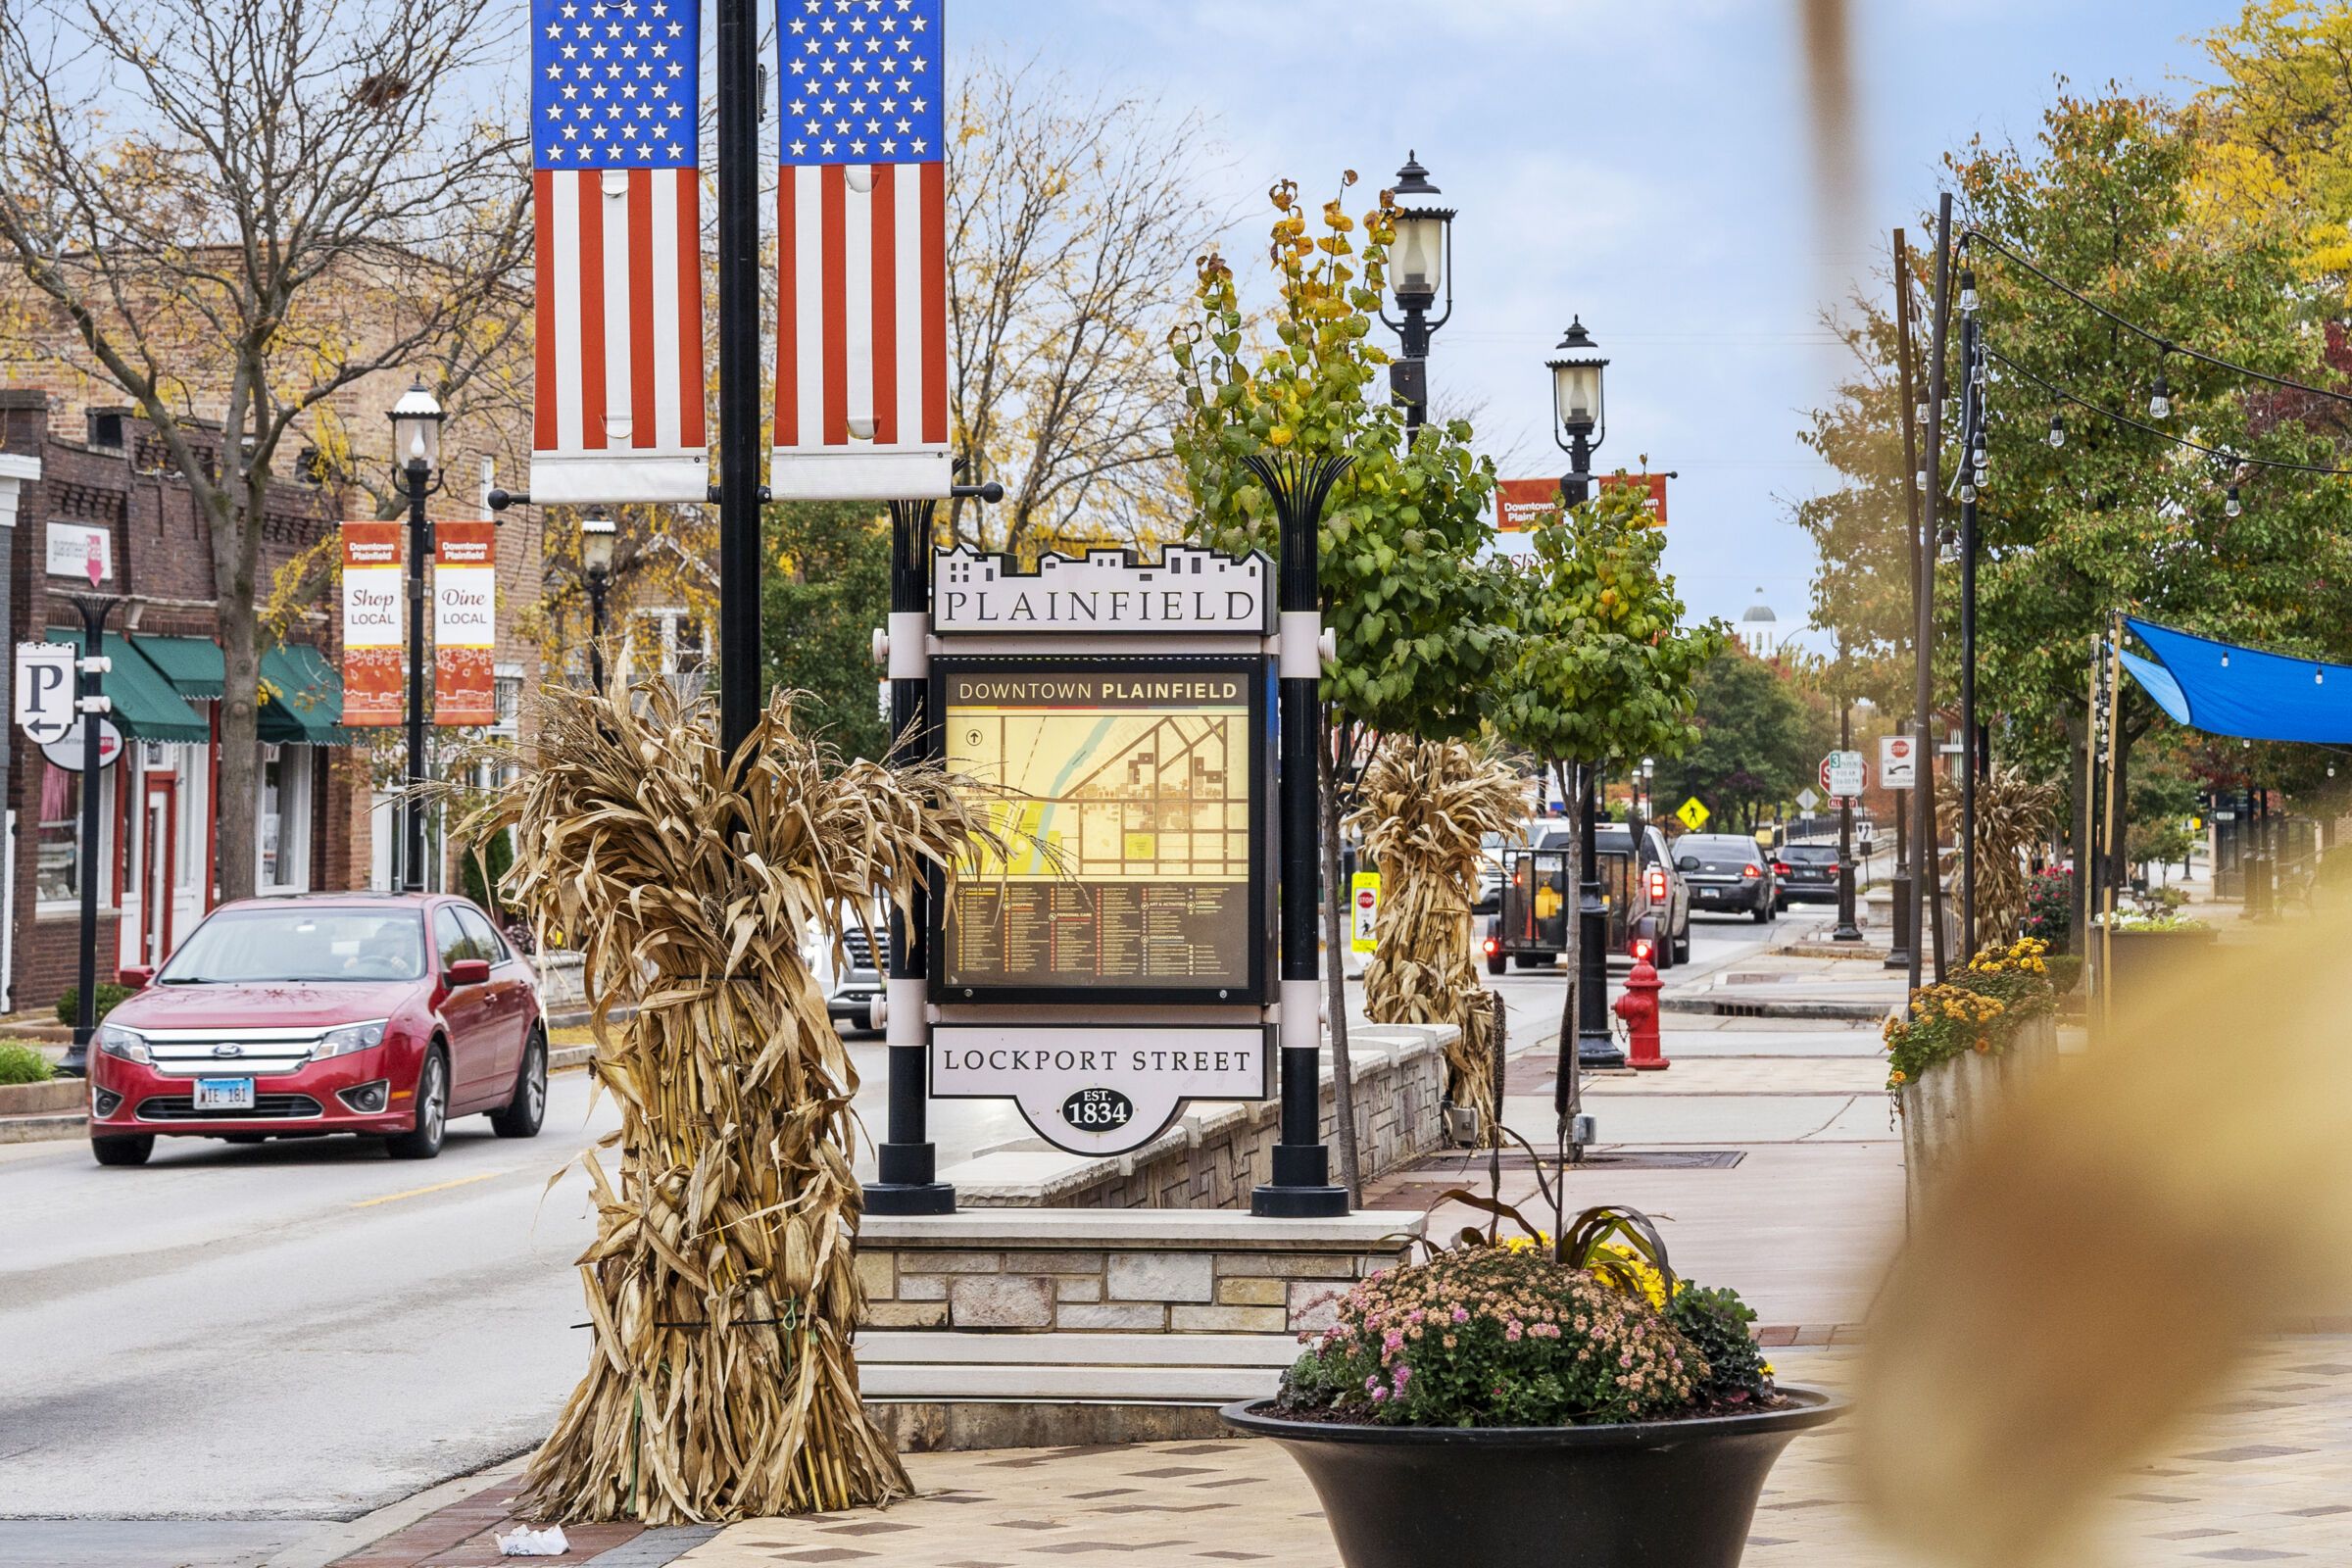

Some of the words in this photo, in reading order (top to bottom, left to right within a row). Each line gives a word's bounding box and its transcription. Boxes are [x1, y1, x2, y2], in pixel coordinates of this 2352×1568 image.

[1504, 502, 1555, 512] Downtown
[1508, 512, 1536, 521] Plainf
[349, 542, 394, 552] Downtown
[442, 542, 487, 551] Downtown
[352, 551, 391, 561] Plainfield
[445, 551, 485, 560] Plainfield
[351, 589, 394, 612] Shop
[442, 588, 485, 607] Dine
[944, 590, 1255, 621] PLAINFIELD
[351, 613, 395, 624] LOCAL
[443, 613, 487, 624] LOCAL
[24, 664, 63, 712] P
[959, 683, 1092, 699] DOWNTOWN
[1102, 683, 1238, 699] PLAINFIELD
[944, 1050, 1117, 1071] LOCKPORT
[1133, 1051, 1251, 1072] STREET
[1083, 1090, 1111, 1102] EST.
[1068, 1102, 1127, 1124] 1834
